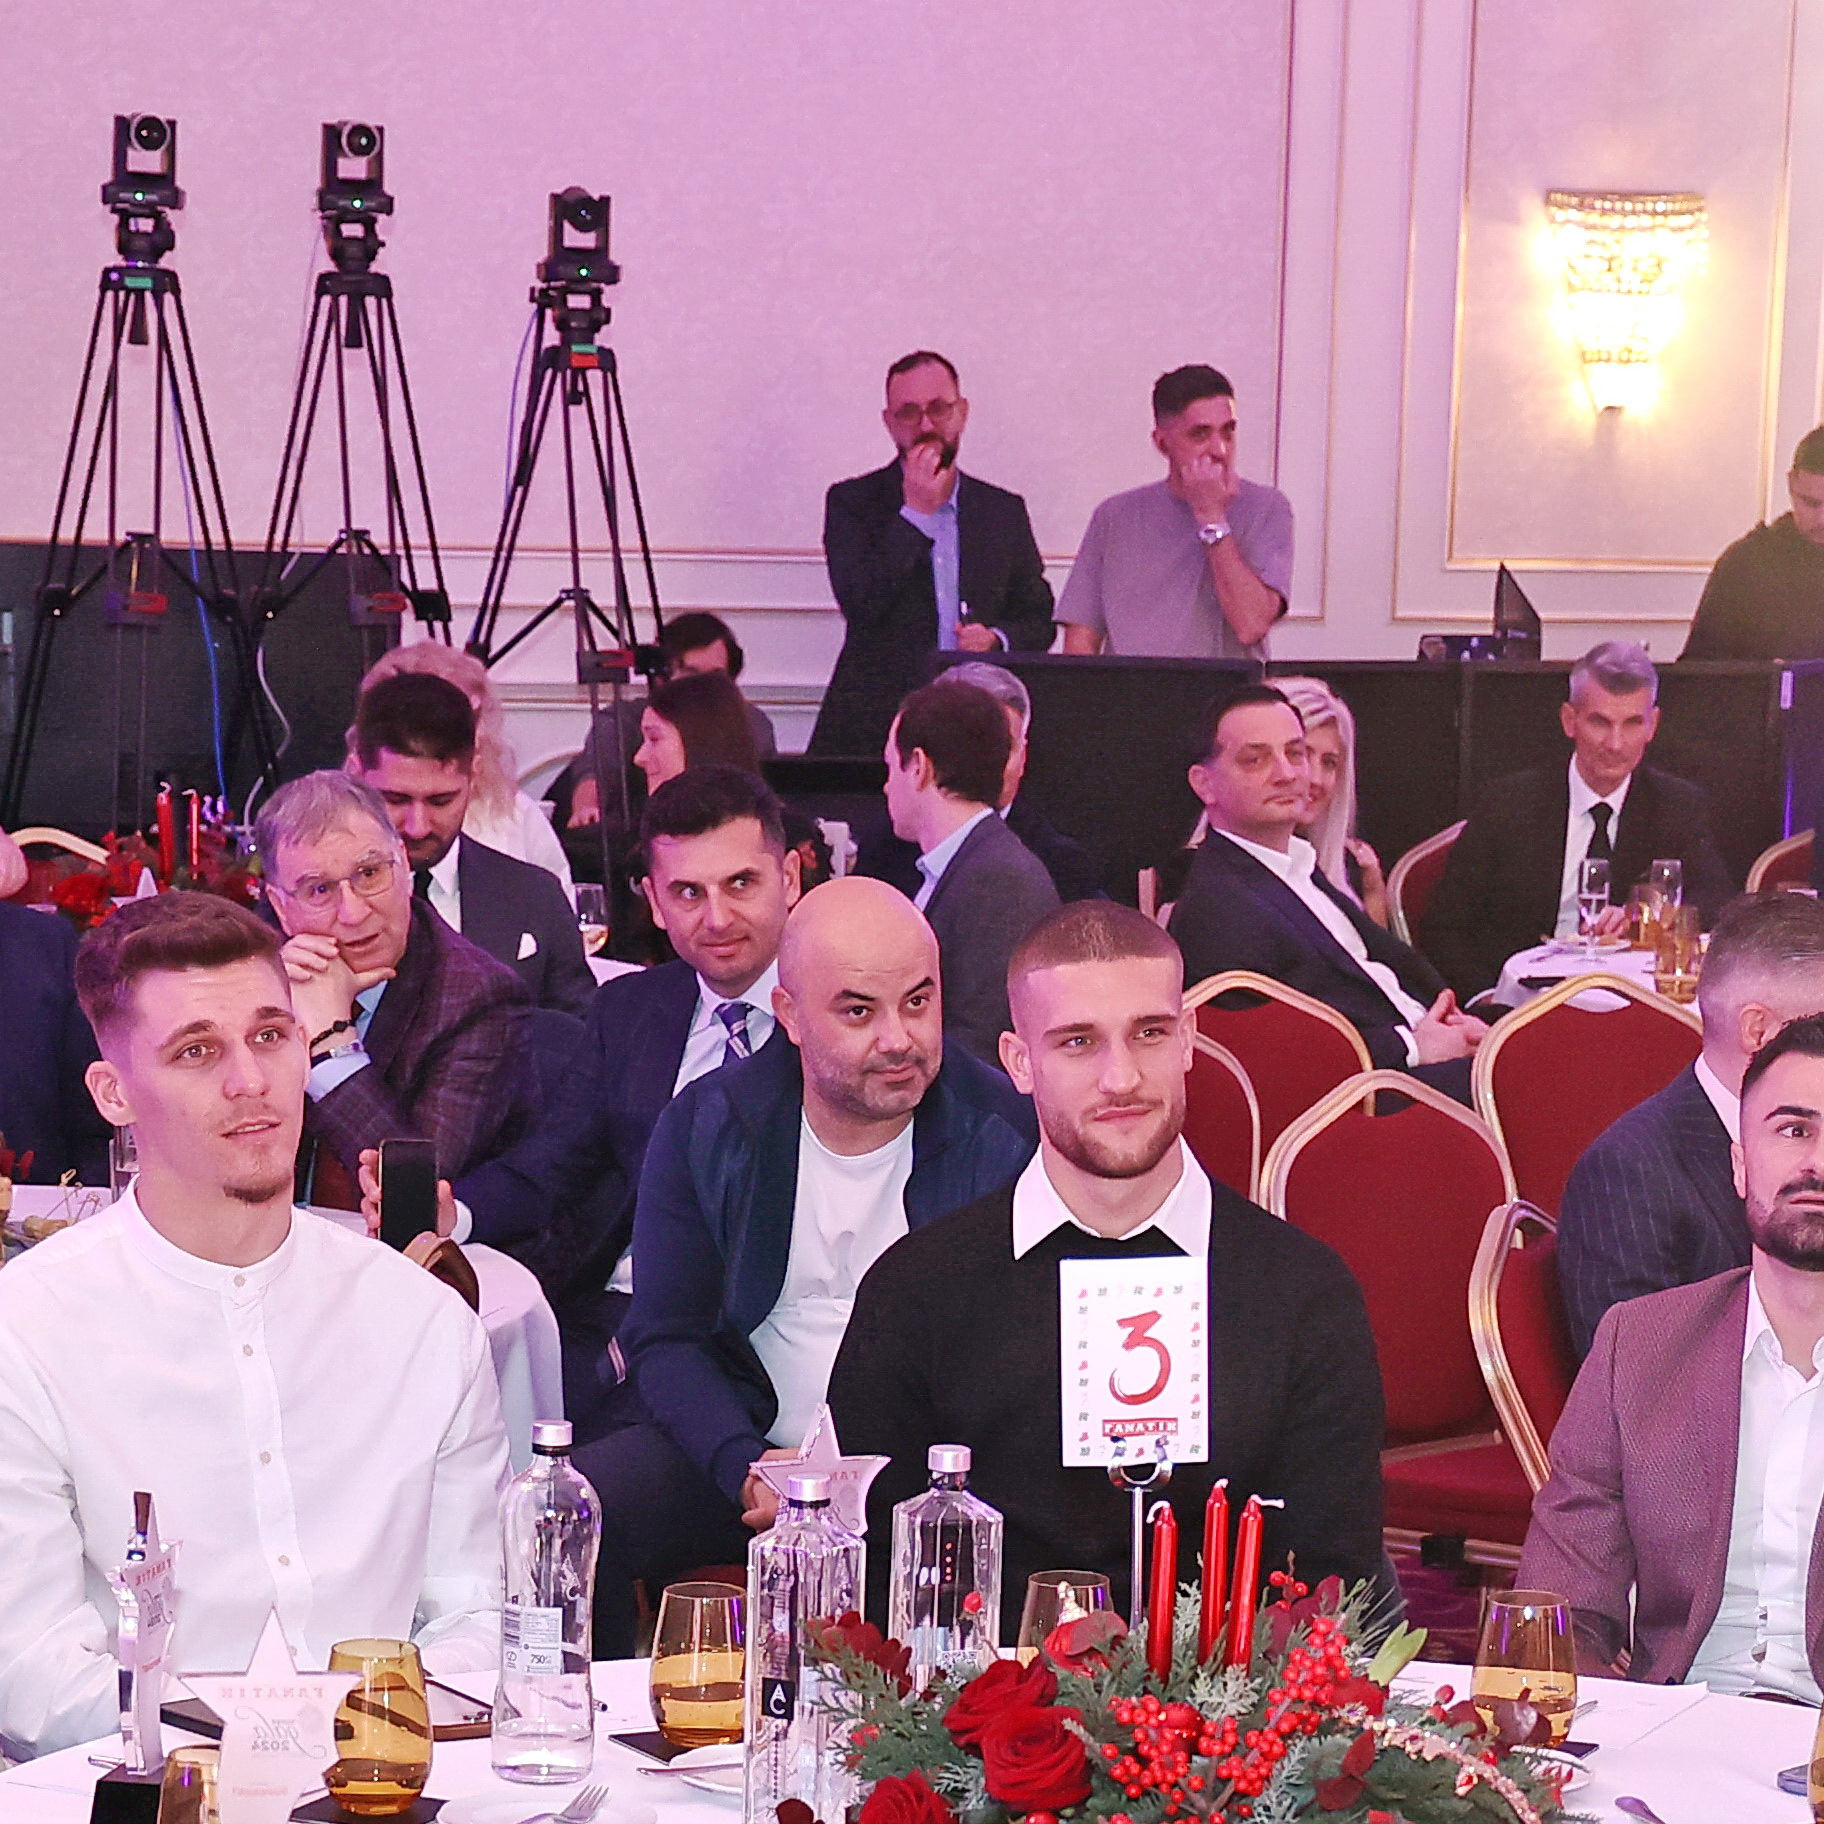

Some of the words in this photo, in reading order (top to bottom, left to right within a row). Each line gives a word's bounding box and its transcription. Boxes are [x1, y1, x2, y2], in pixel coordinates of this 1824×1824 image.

[1108, 1310, 1172, 1406] 3
[1104, 1420, 1178, 1435] FANATIK
[530, 1653, 546, 1665] 750
